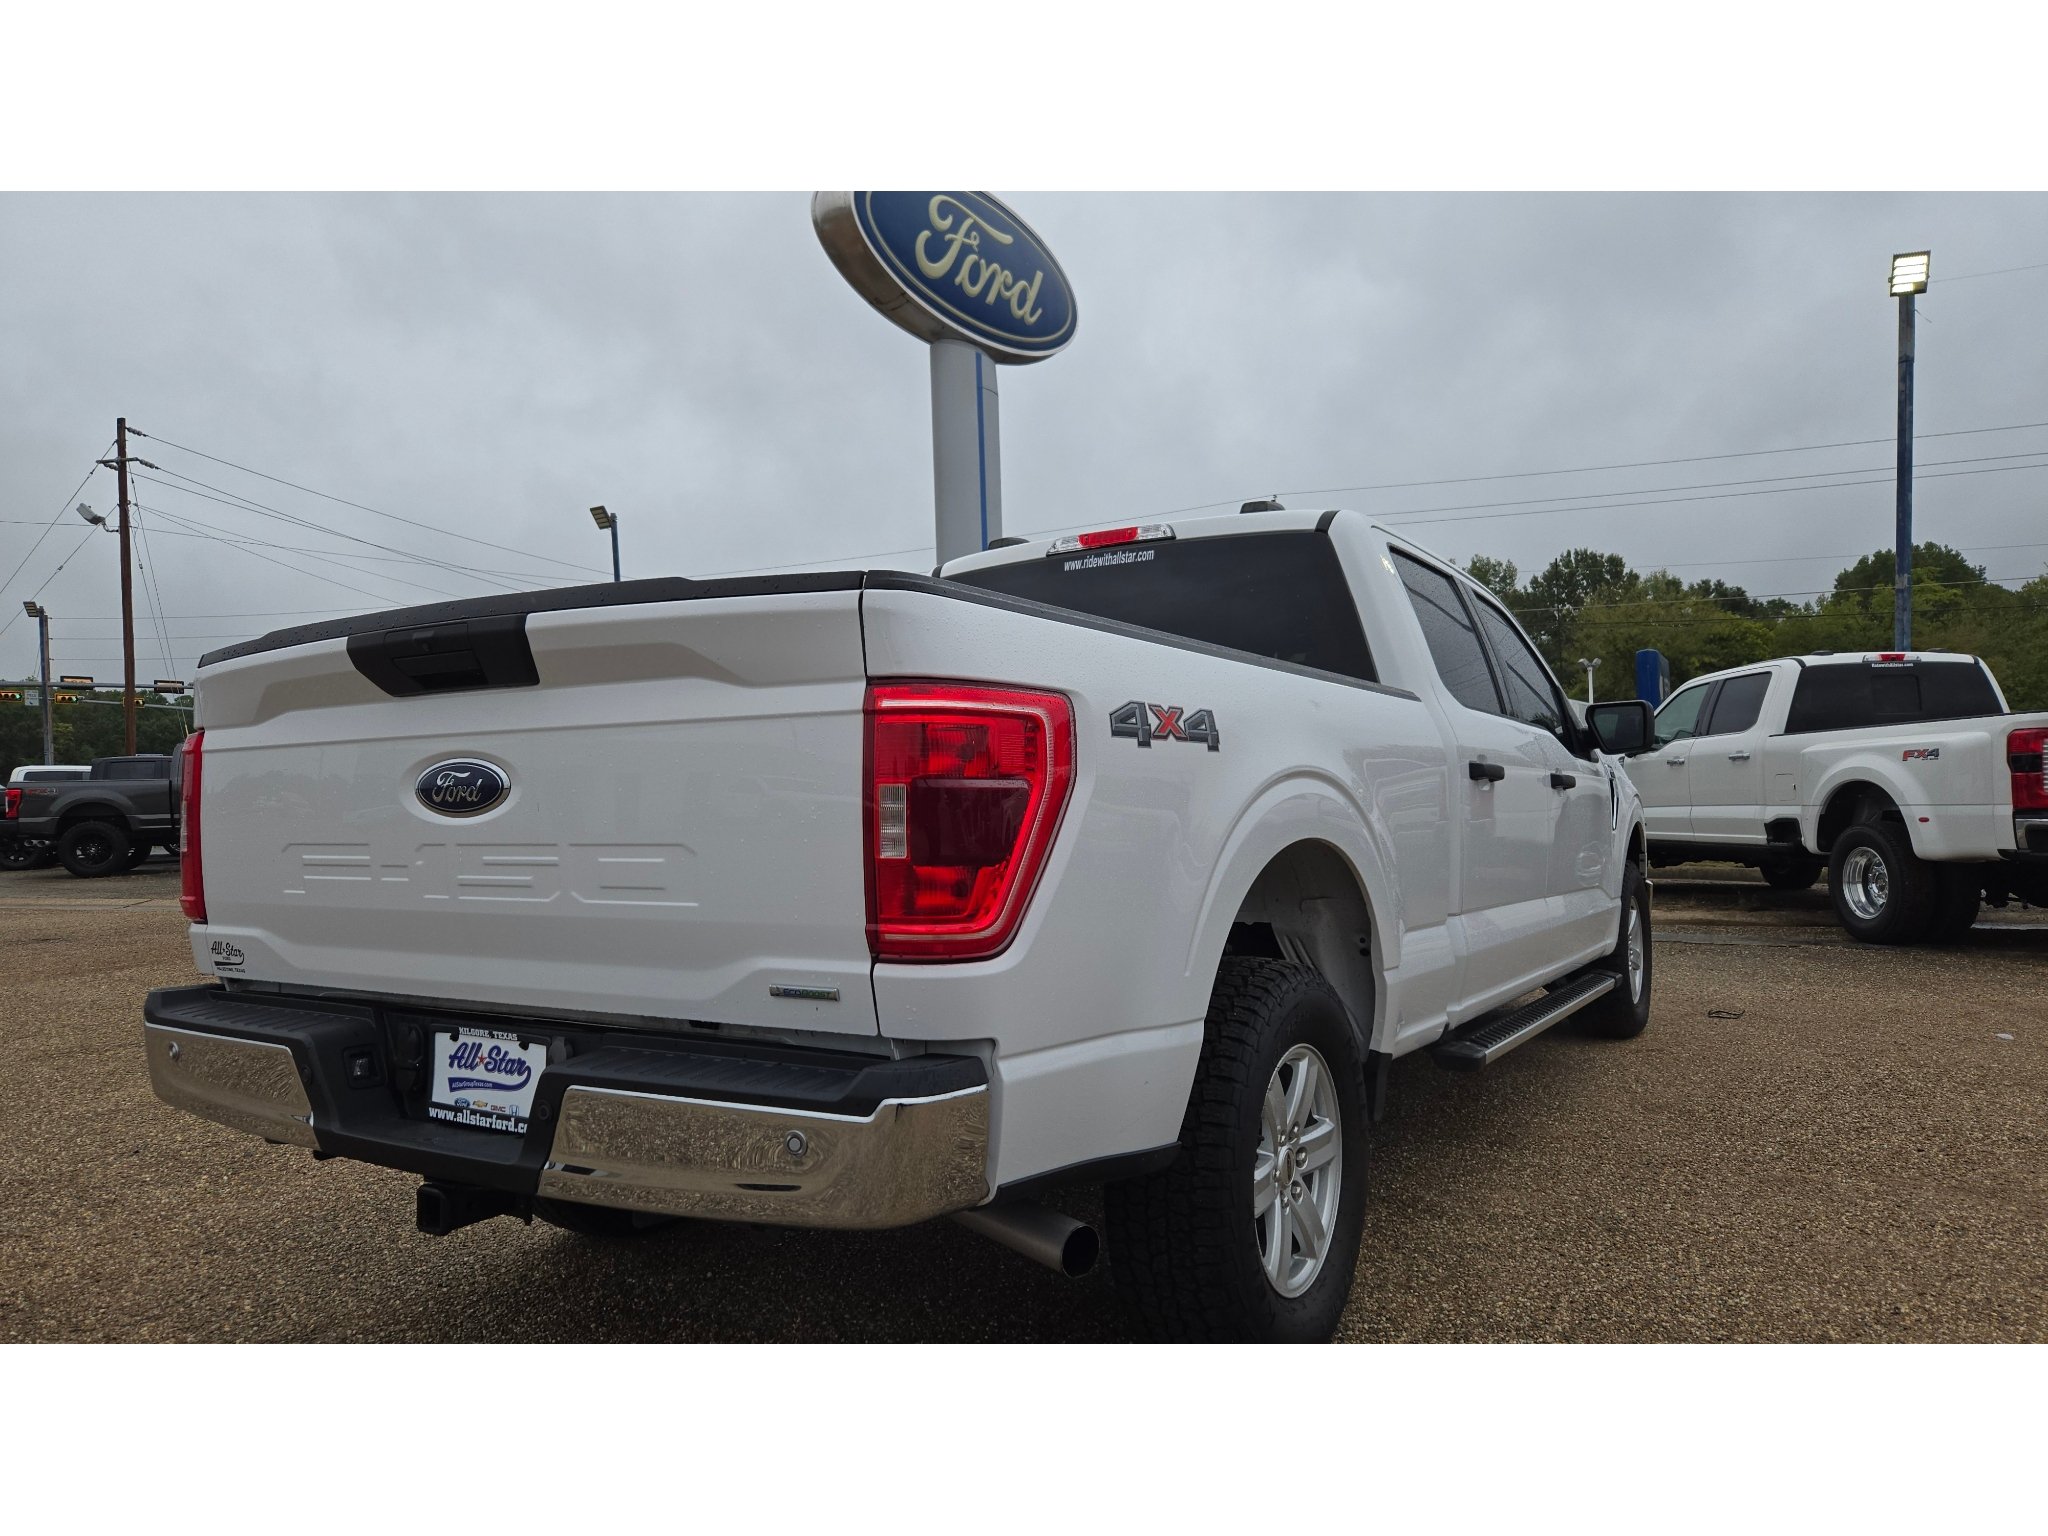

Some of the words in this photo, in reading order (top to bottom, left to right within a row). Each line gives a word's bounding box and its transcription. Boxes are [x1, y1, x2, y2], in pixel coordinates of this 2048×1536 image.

[914, 194, 1044, 326] Ford
[1063, 549, 1155, 572] www.ridewithallstar.com
[1902, 748, 1940, 762] FX4
[431, 770, 483, 803] Ford
[493, 1031, 518, 1041] TEXAS
[490, 1104, 507, 1113] GMC
